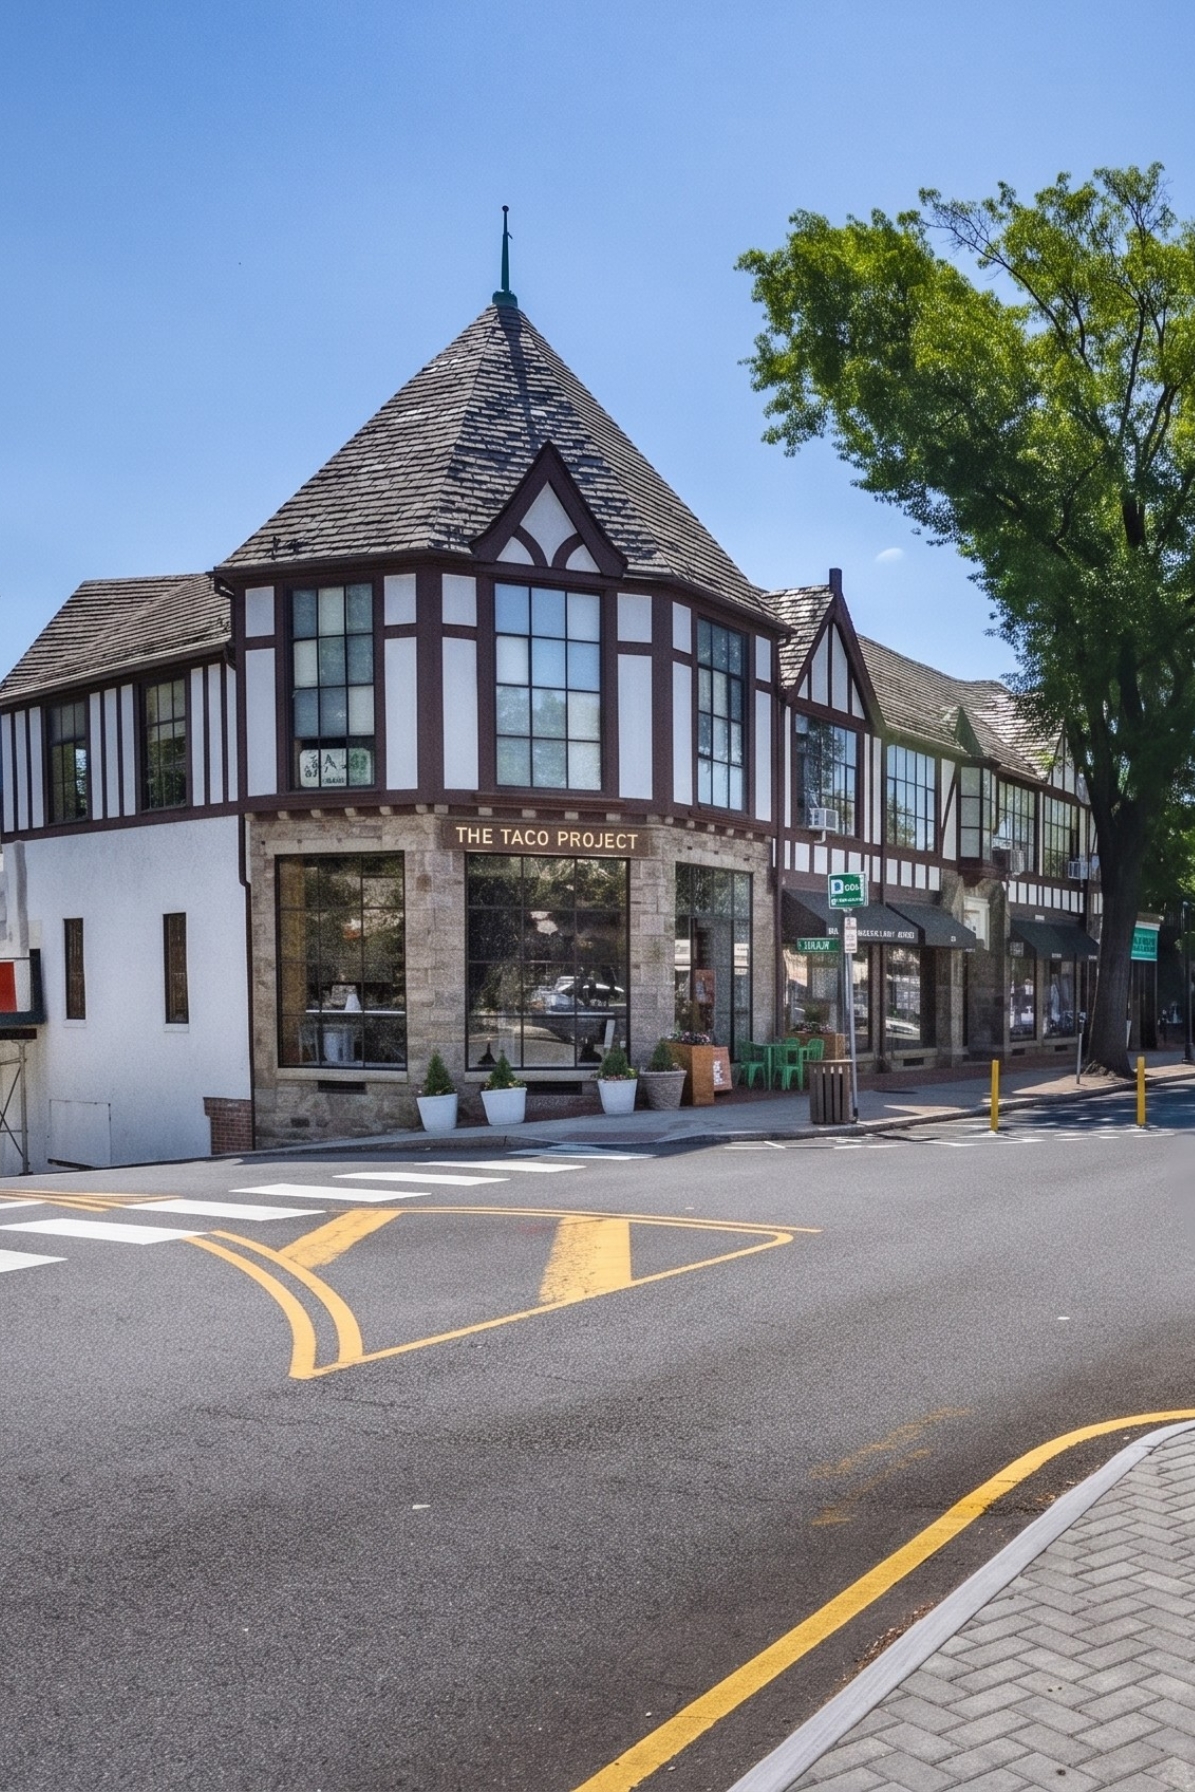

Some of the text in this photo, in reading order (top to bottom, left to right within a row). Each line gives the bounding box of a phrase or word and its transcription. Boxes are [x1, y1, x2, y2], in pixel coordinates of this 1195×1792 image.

[455, 827, 639, 849] THE TACO PROJECT
